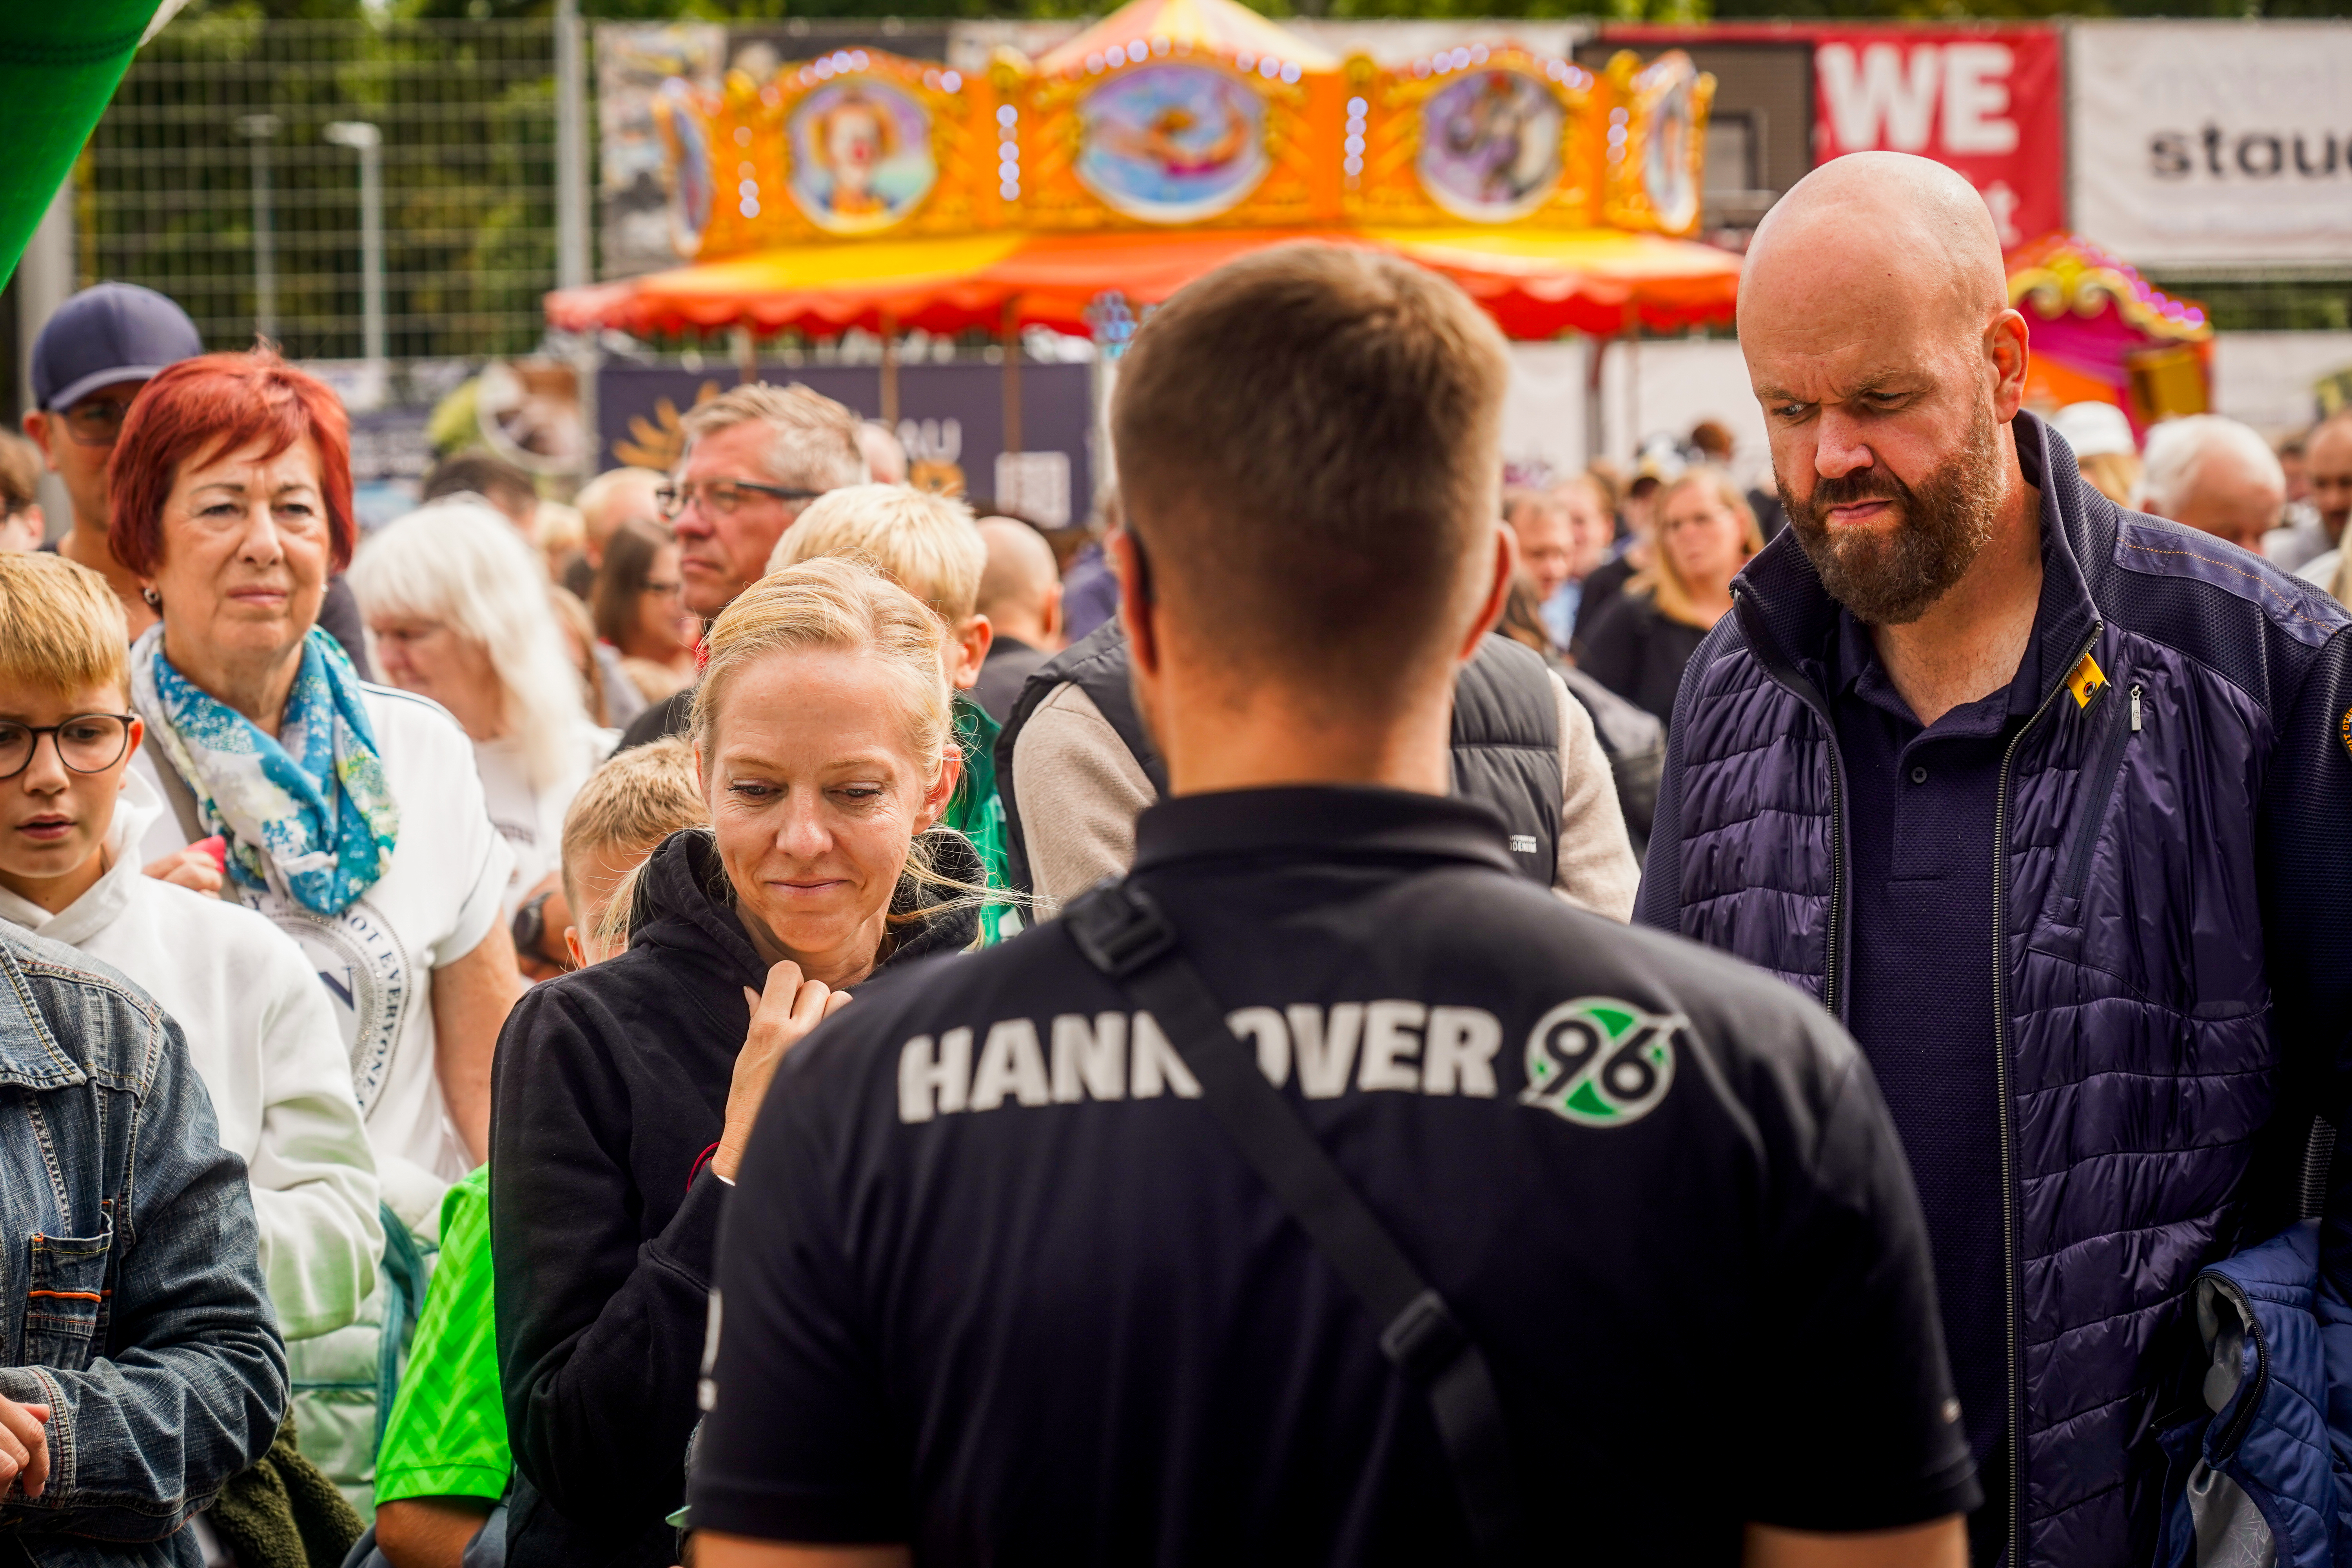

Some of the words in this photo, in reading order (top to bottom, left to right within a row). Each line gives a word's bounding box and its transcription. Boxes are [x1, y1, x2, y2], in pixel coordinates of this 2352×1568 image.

[1817, 42, 2020, 154] WE
[2151, 120, 2352, 179] stau
[341, 908, 383, 942] OT
[1535, 1014, 1666, 1105] 96
